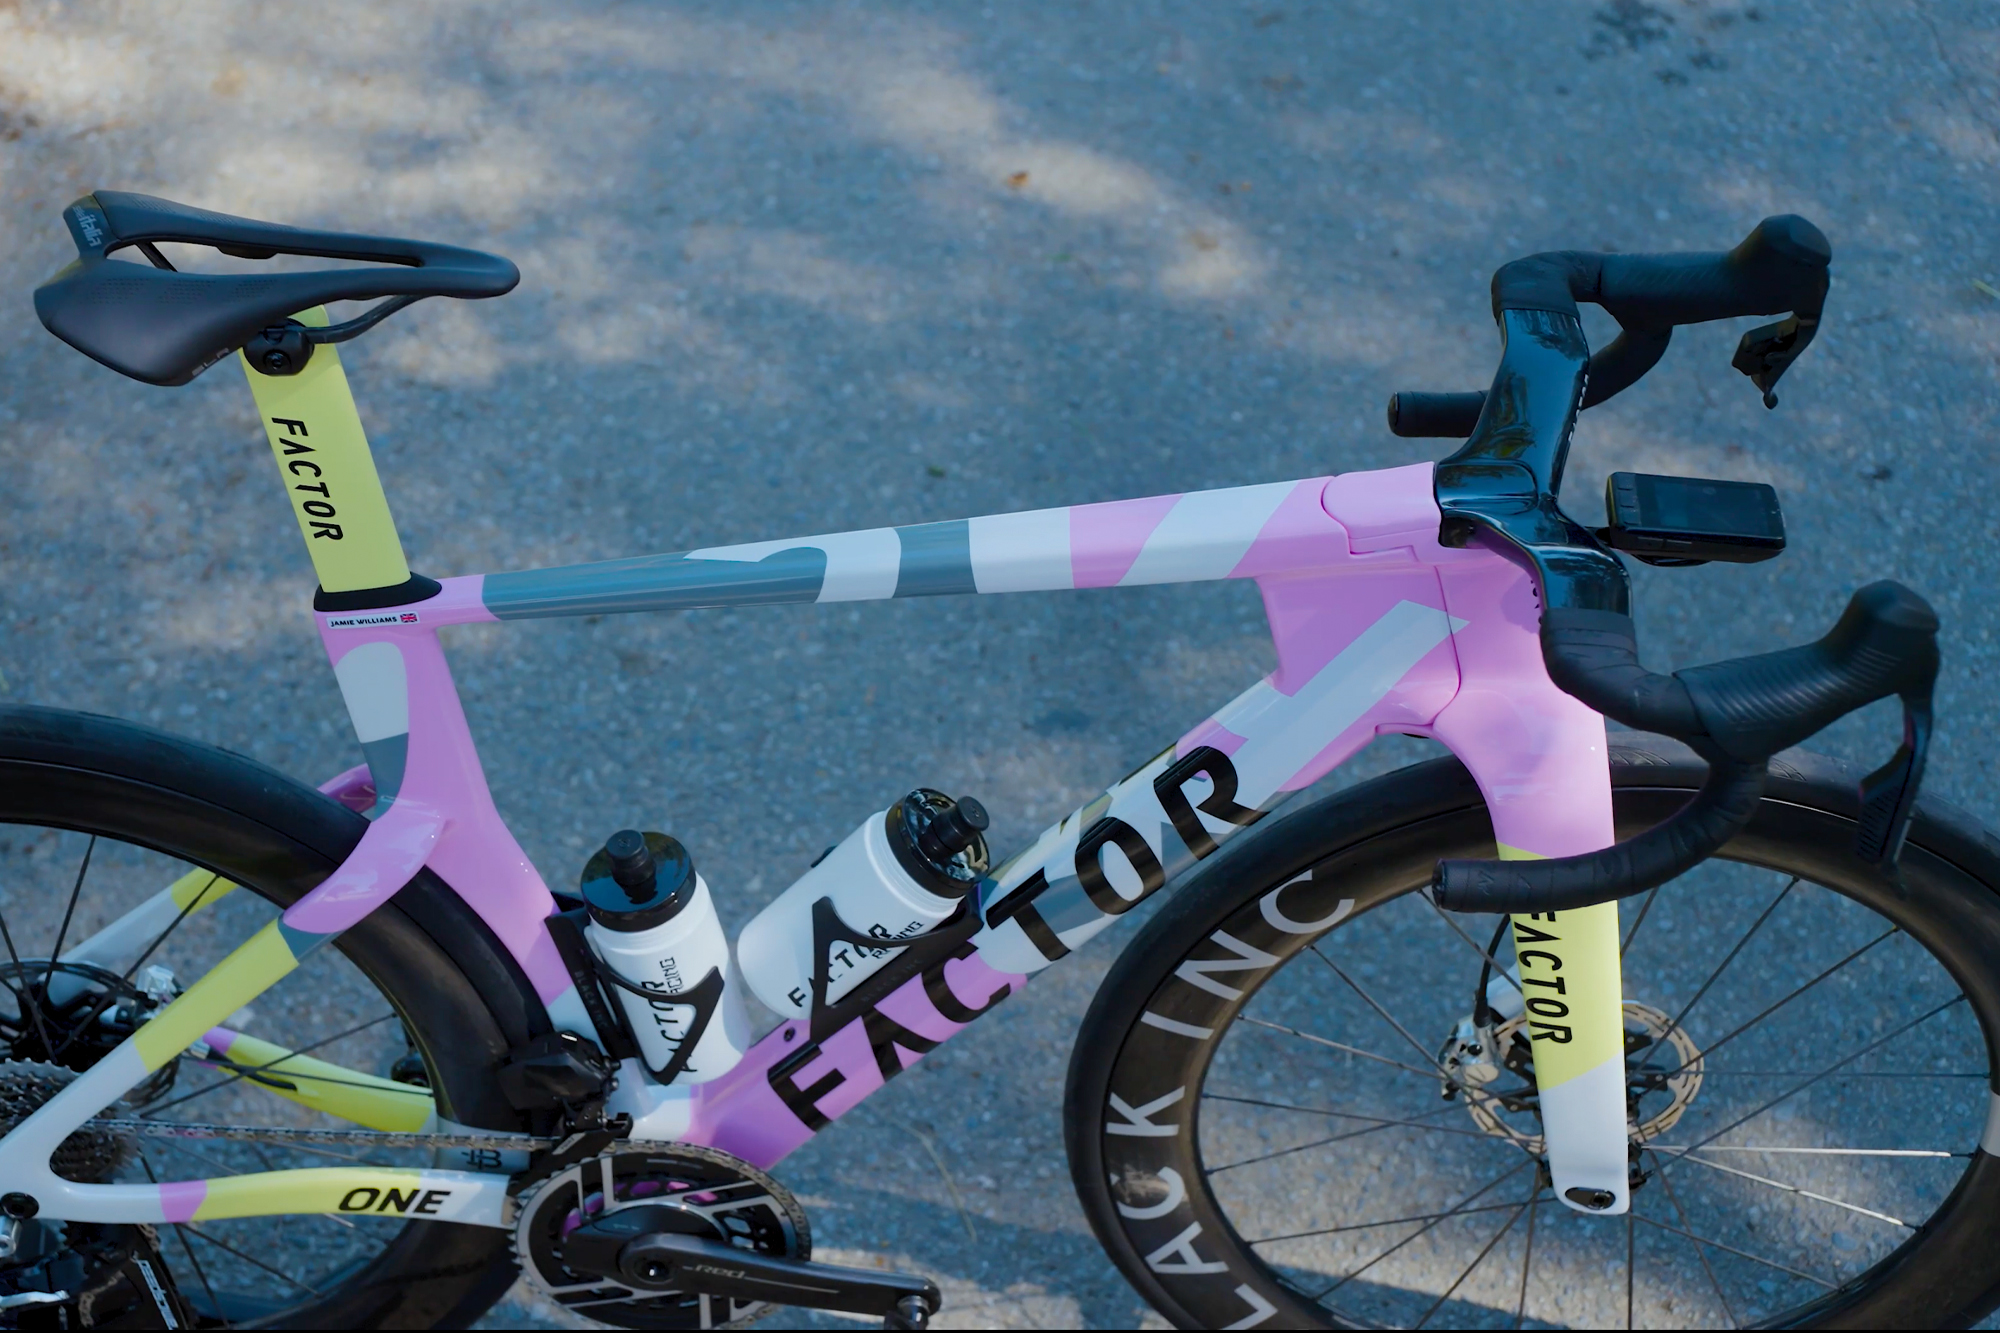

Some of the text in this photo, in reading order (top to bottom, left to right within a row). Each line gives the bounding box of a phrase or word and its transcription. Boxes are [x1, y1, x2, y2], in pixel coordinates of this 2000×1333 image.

[271, 417, 344, 541] FACTOR
[330, 616, 398, 628] JAMIE WILLIAMS
[767, 745, 1271, 1132] FACTOR
[1140, 869, 1355, 1040] INC
[338, 1187, 452, 1214] ONE
